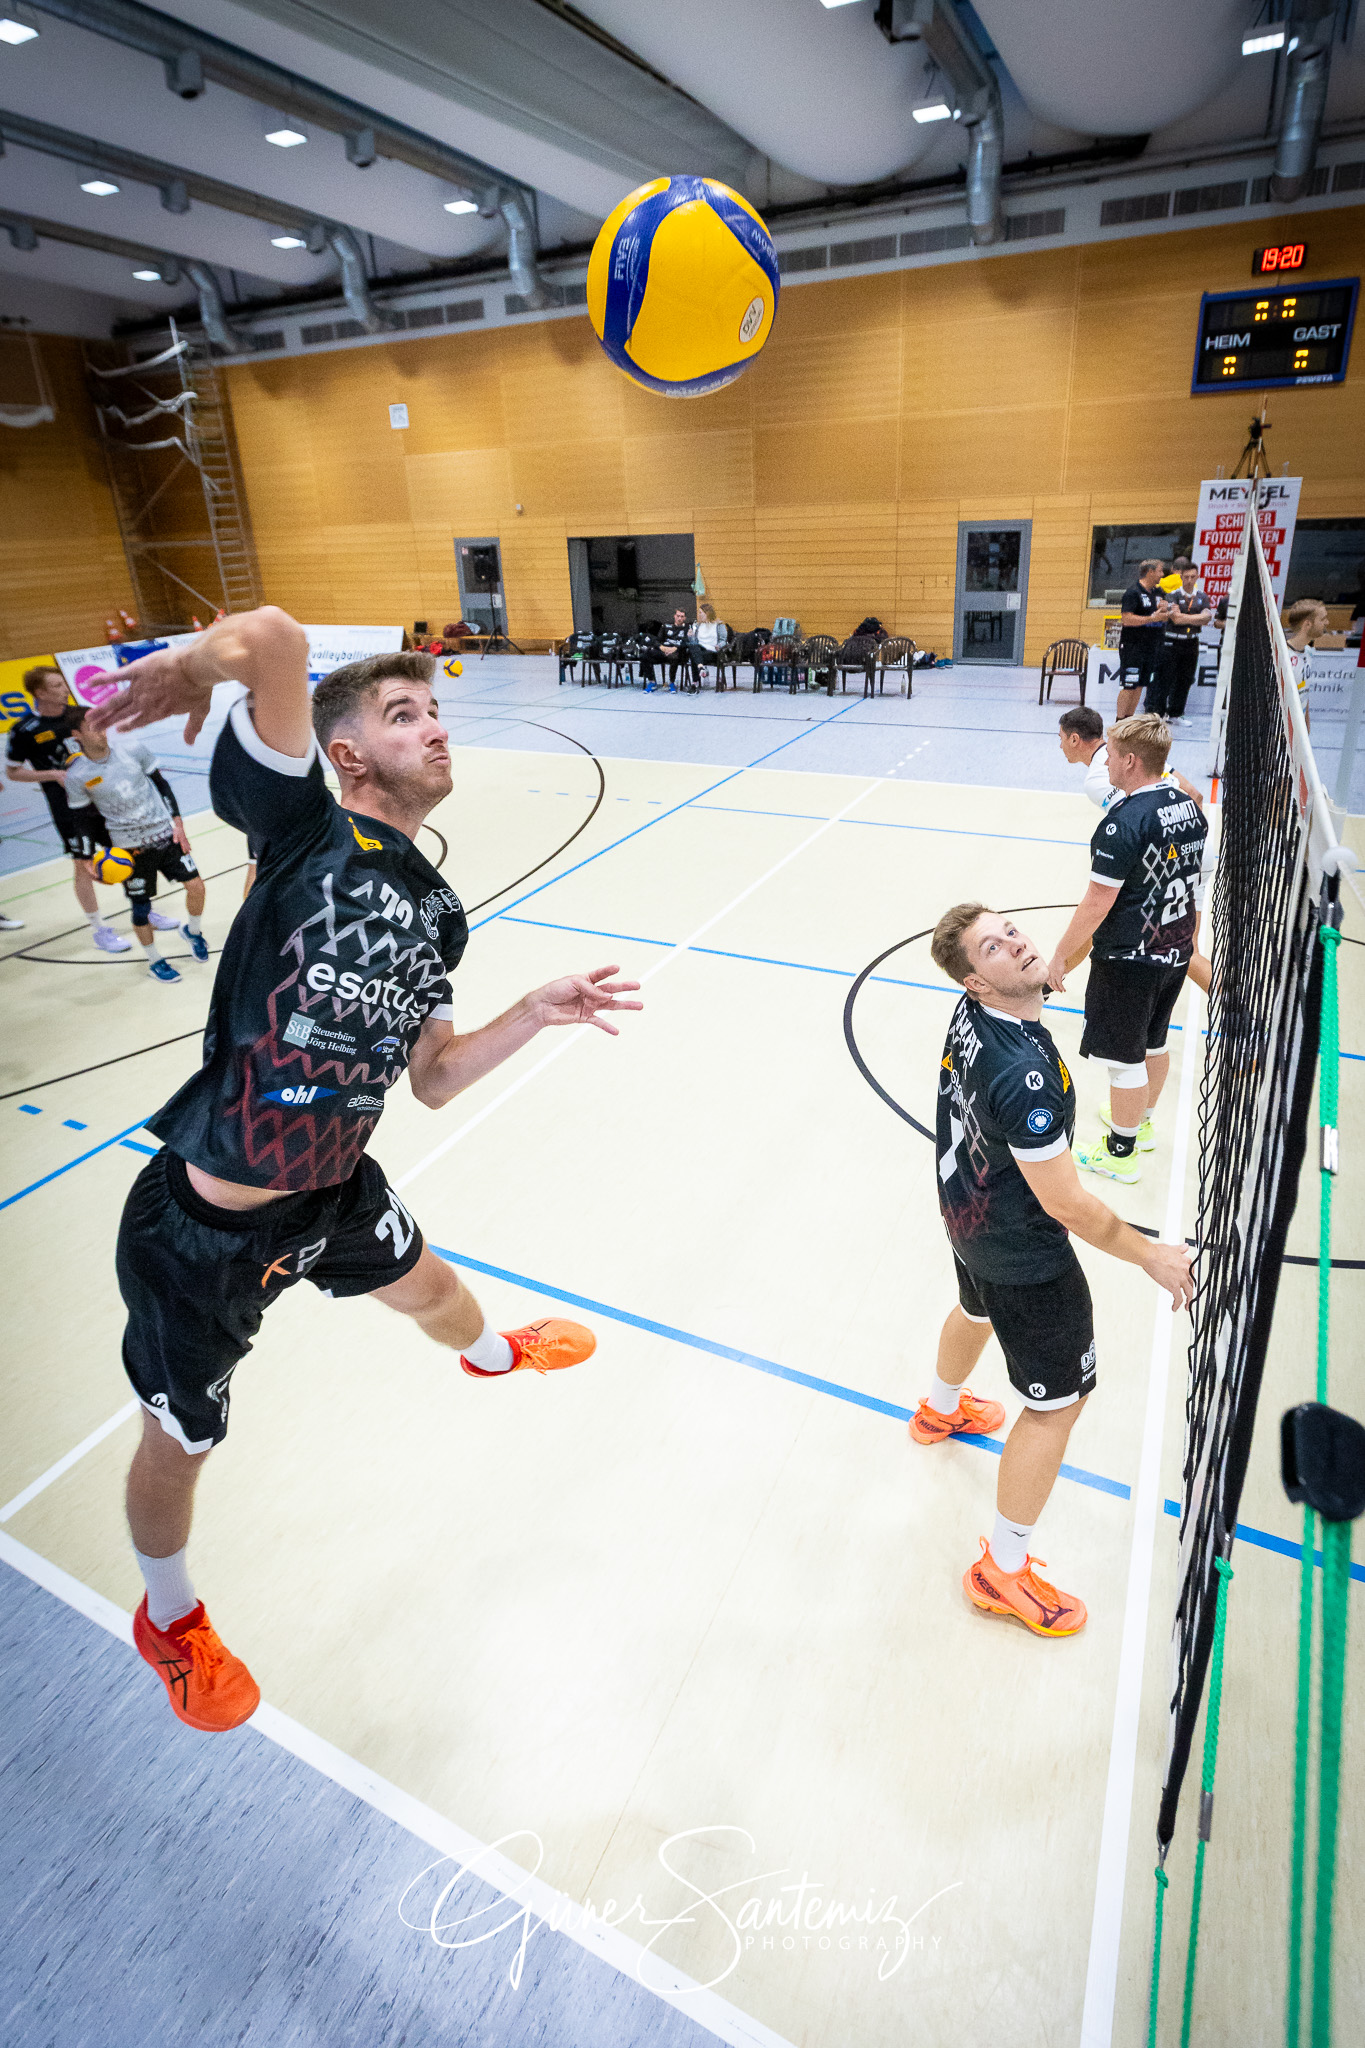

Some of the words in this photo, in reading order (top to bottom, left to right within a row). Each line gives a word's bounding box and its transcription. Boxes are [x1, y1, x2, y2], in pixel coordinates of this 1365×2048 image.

[1261, 244, 1305, 272] 19:20
[1205, 332, 1251, 351] HEIM
[1293, 323, 1342, 342] GAST
[1218, 512, 1272, 528] SCHIER
[285, 1019, 313, 1041] StB
[311, 1025, 356, 1043] Steuerbüro
[307, 1036, 328, 1050] Jörg
[327, 1041, 358, 1056] Helbing
[281, 1085, 319, 1104] ohl
